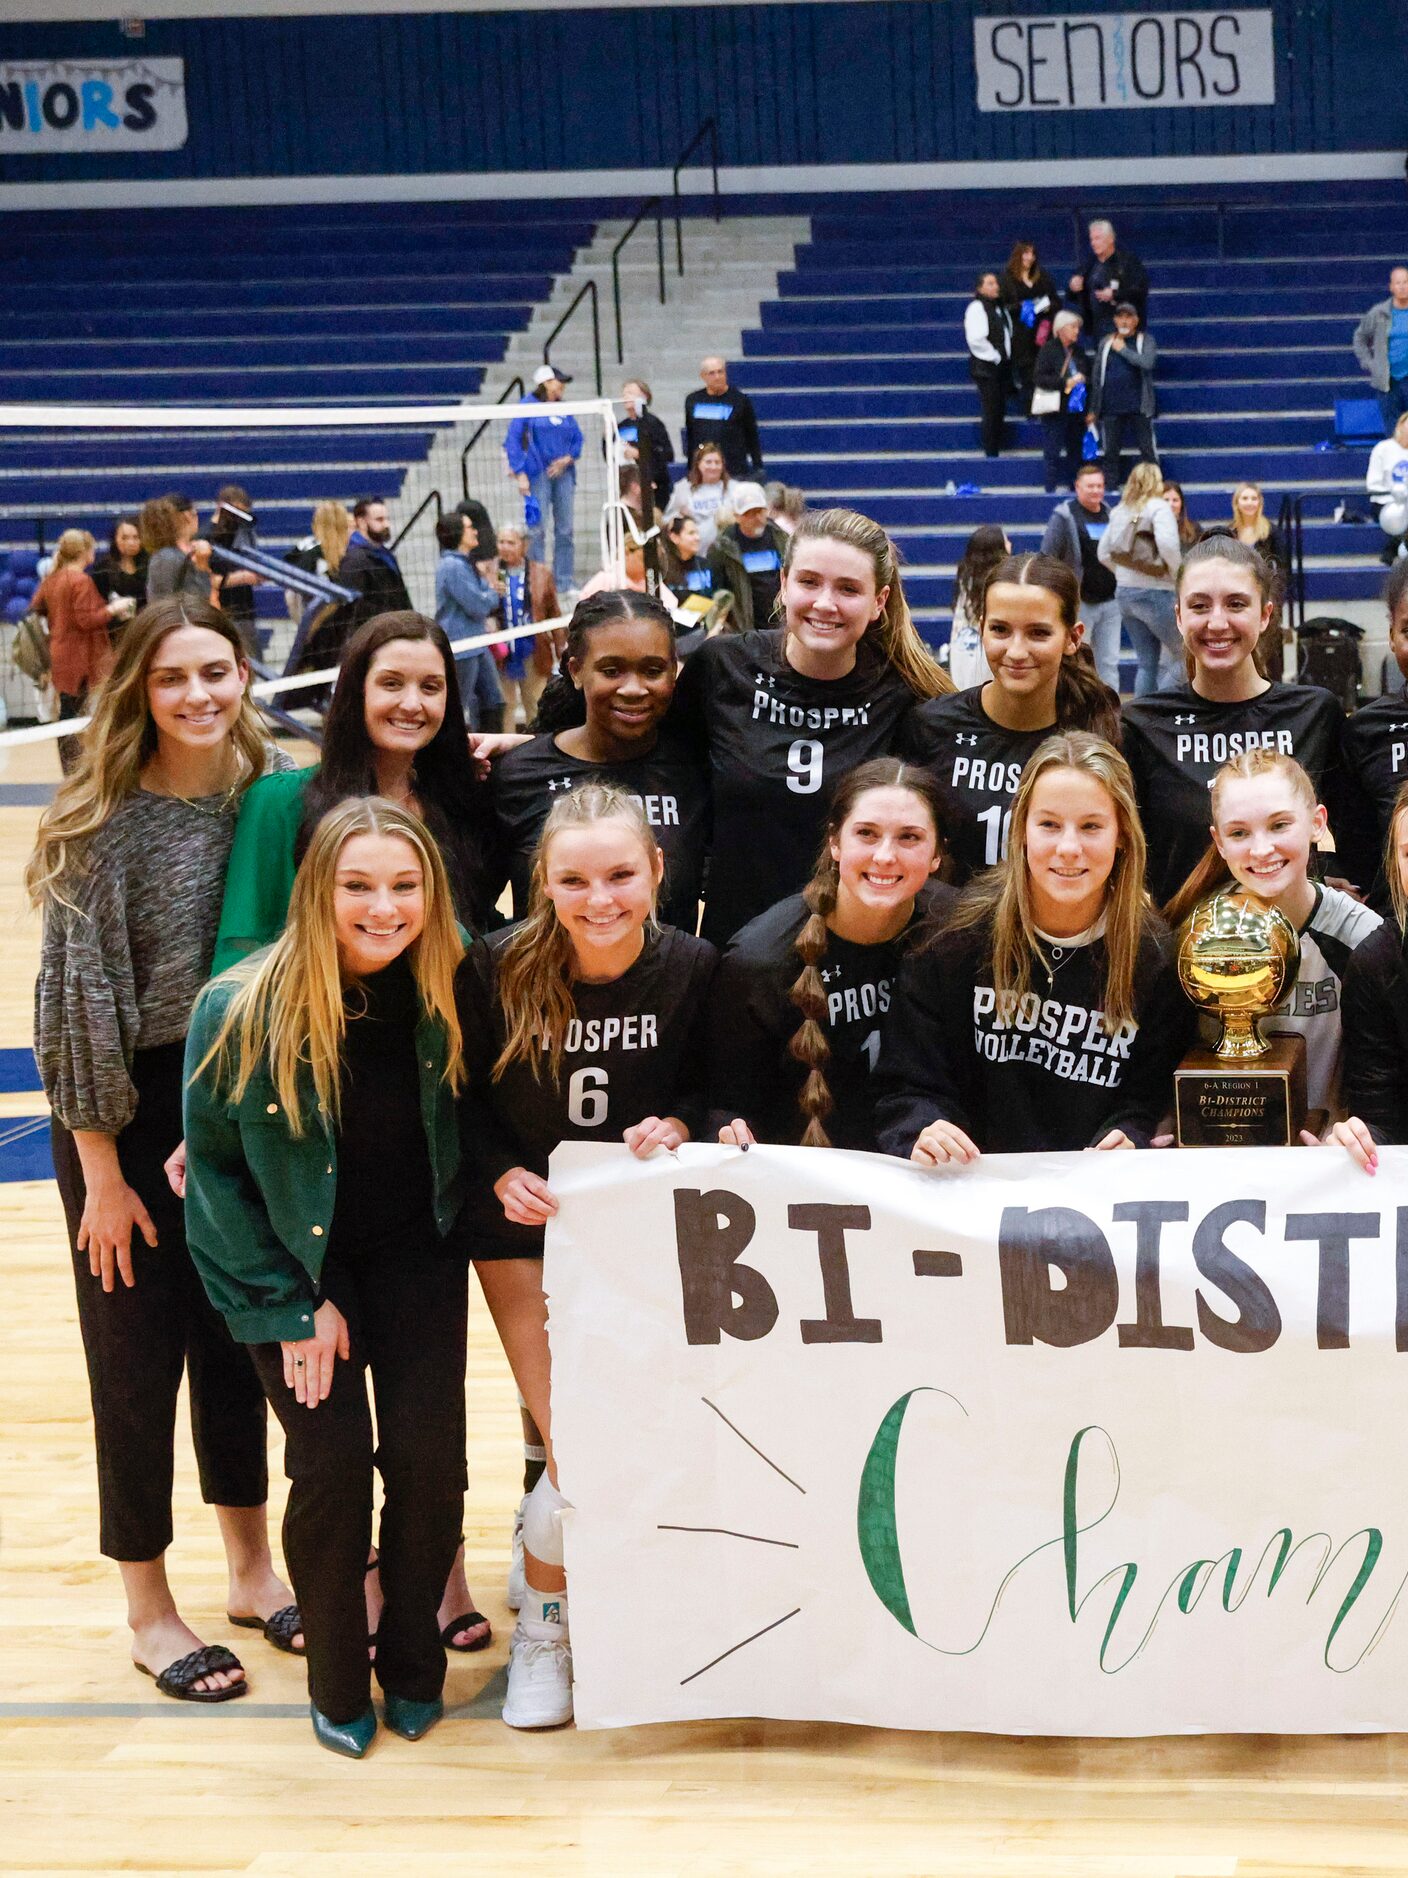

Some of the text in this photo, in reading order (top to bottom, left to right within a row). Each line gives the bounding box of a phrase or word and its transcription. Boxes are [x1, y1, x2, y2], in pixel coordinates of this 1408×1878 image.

[786, 740, 824, 794] 9
[973, 986, 1139, 1060] PROSPER
[974, 1027, 1122, 1088] VOLLEYBALL
[568, 1067, 609, 1127] 6
